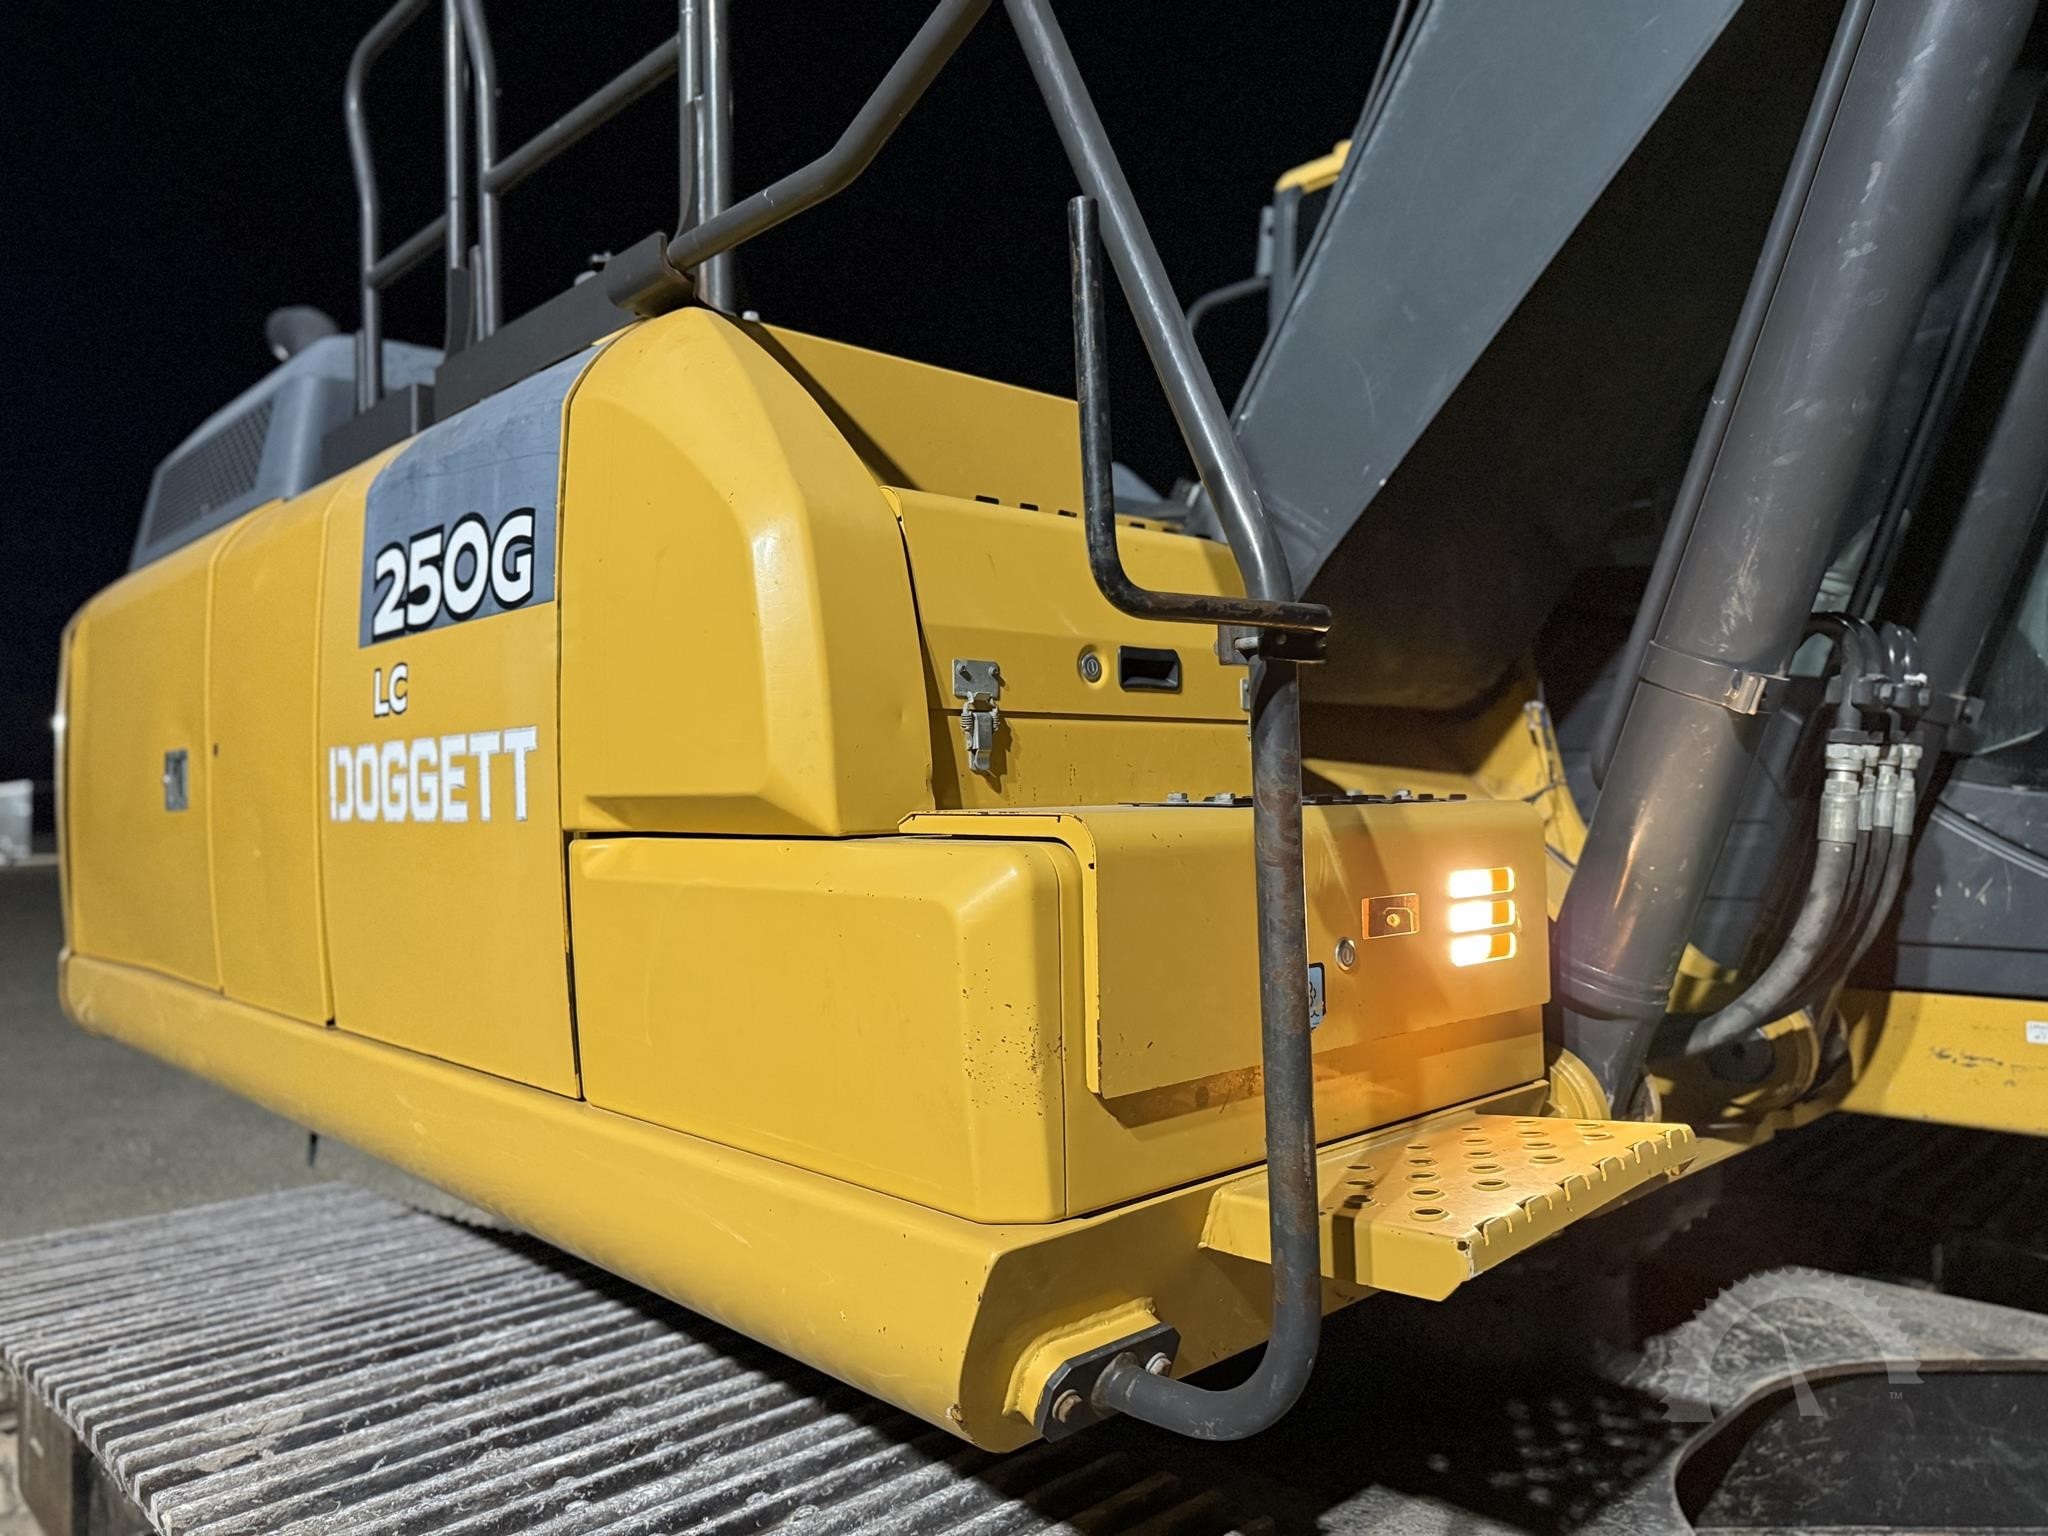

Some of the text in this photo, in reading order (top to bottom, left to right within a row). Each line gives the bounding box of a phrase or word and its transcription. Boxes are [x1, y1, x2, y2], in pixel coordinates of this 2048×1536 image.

[372, 508, 535, 642] 250G
[373, 663, 408, 717] LC
[329, 725, 537, 822] DOGGETT
